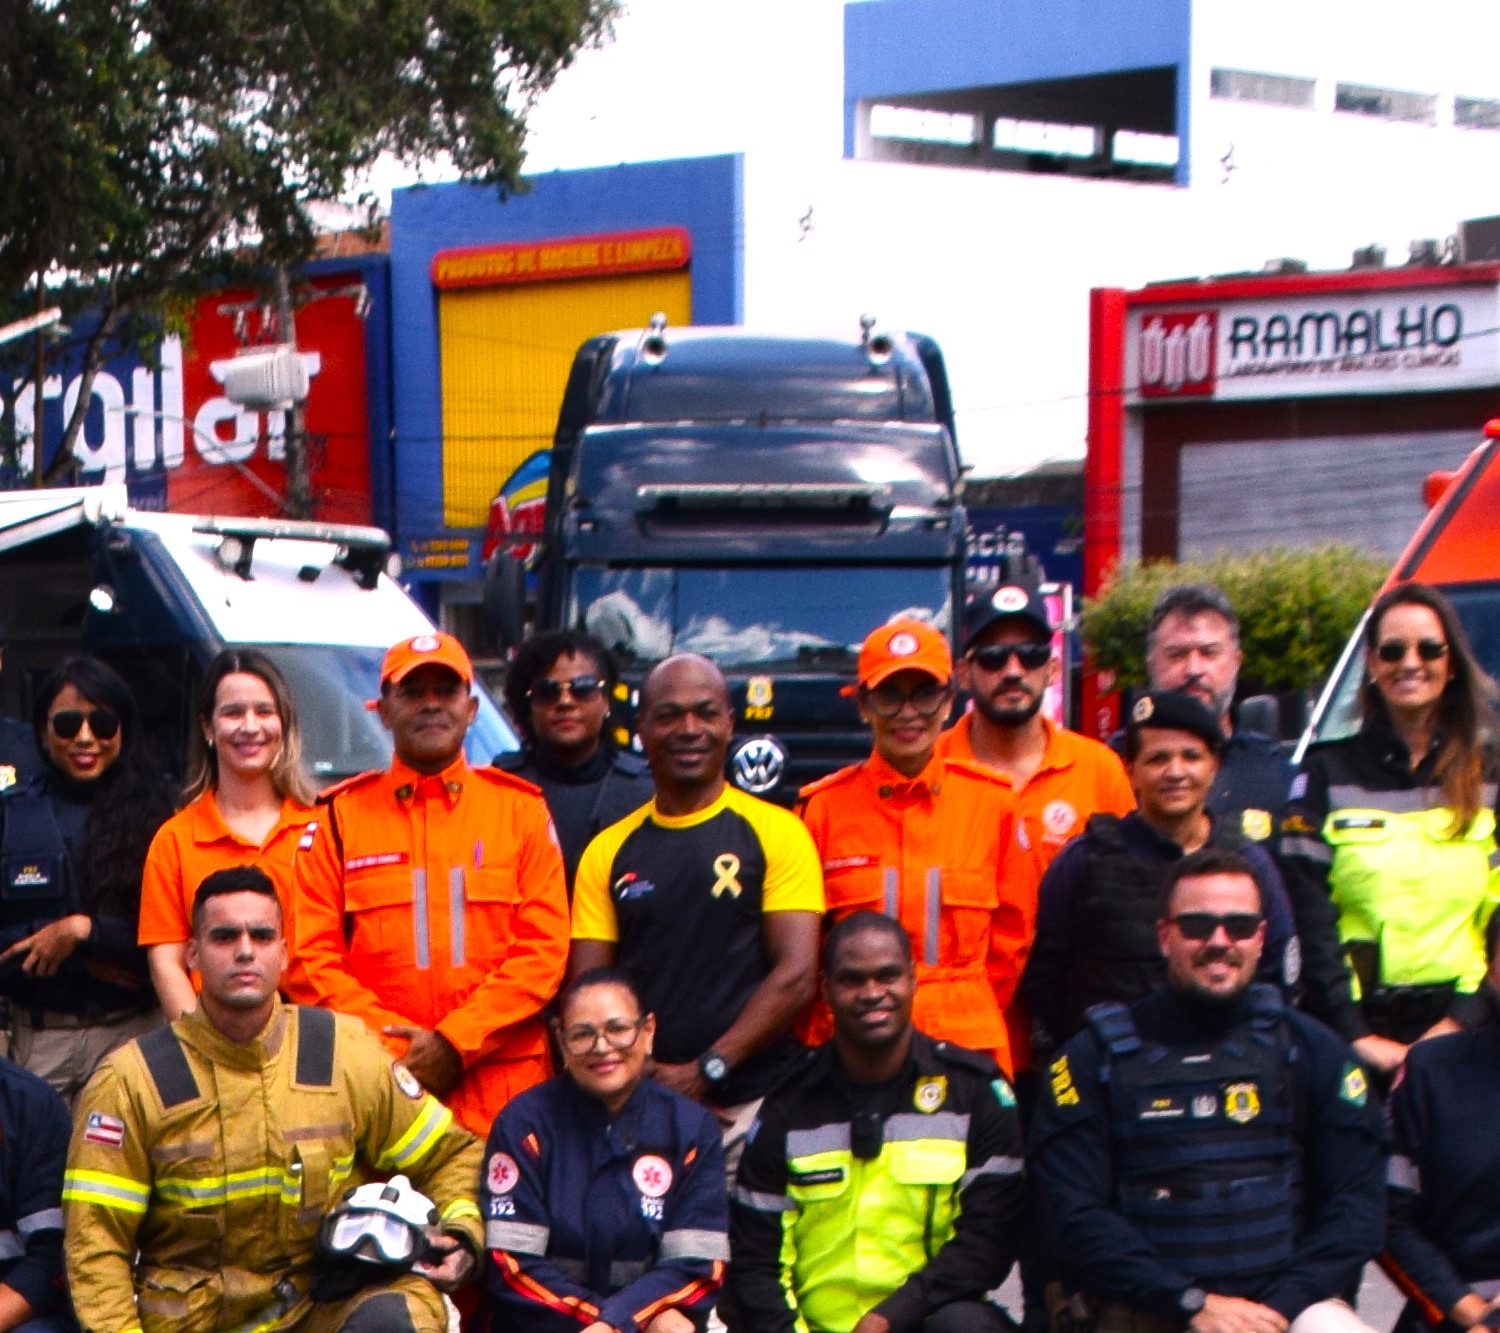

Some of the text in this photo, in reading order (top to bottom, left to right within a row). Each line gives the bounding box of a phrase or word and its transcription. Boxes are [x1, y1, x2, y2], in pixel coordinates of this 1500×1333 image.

[1229, 303, 1464, 357] RAMALHO
[1050, 1055, 1080, 1107] PRF
[490, 1201, 516, 1216] 192
[641, 1203, 664, 1221] 192
